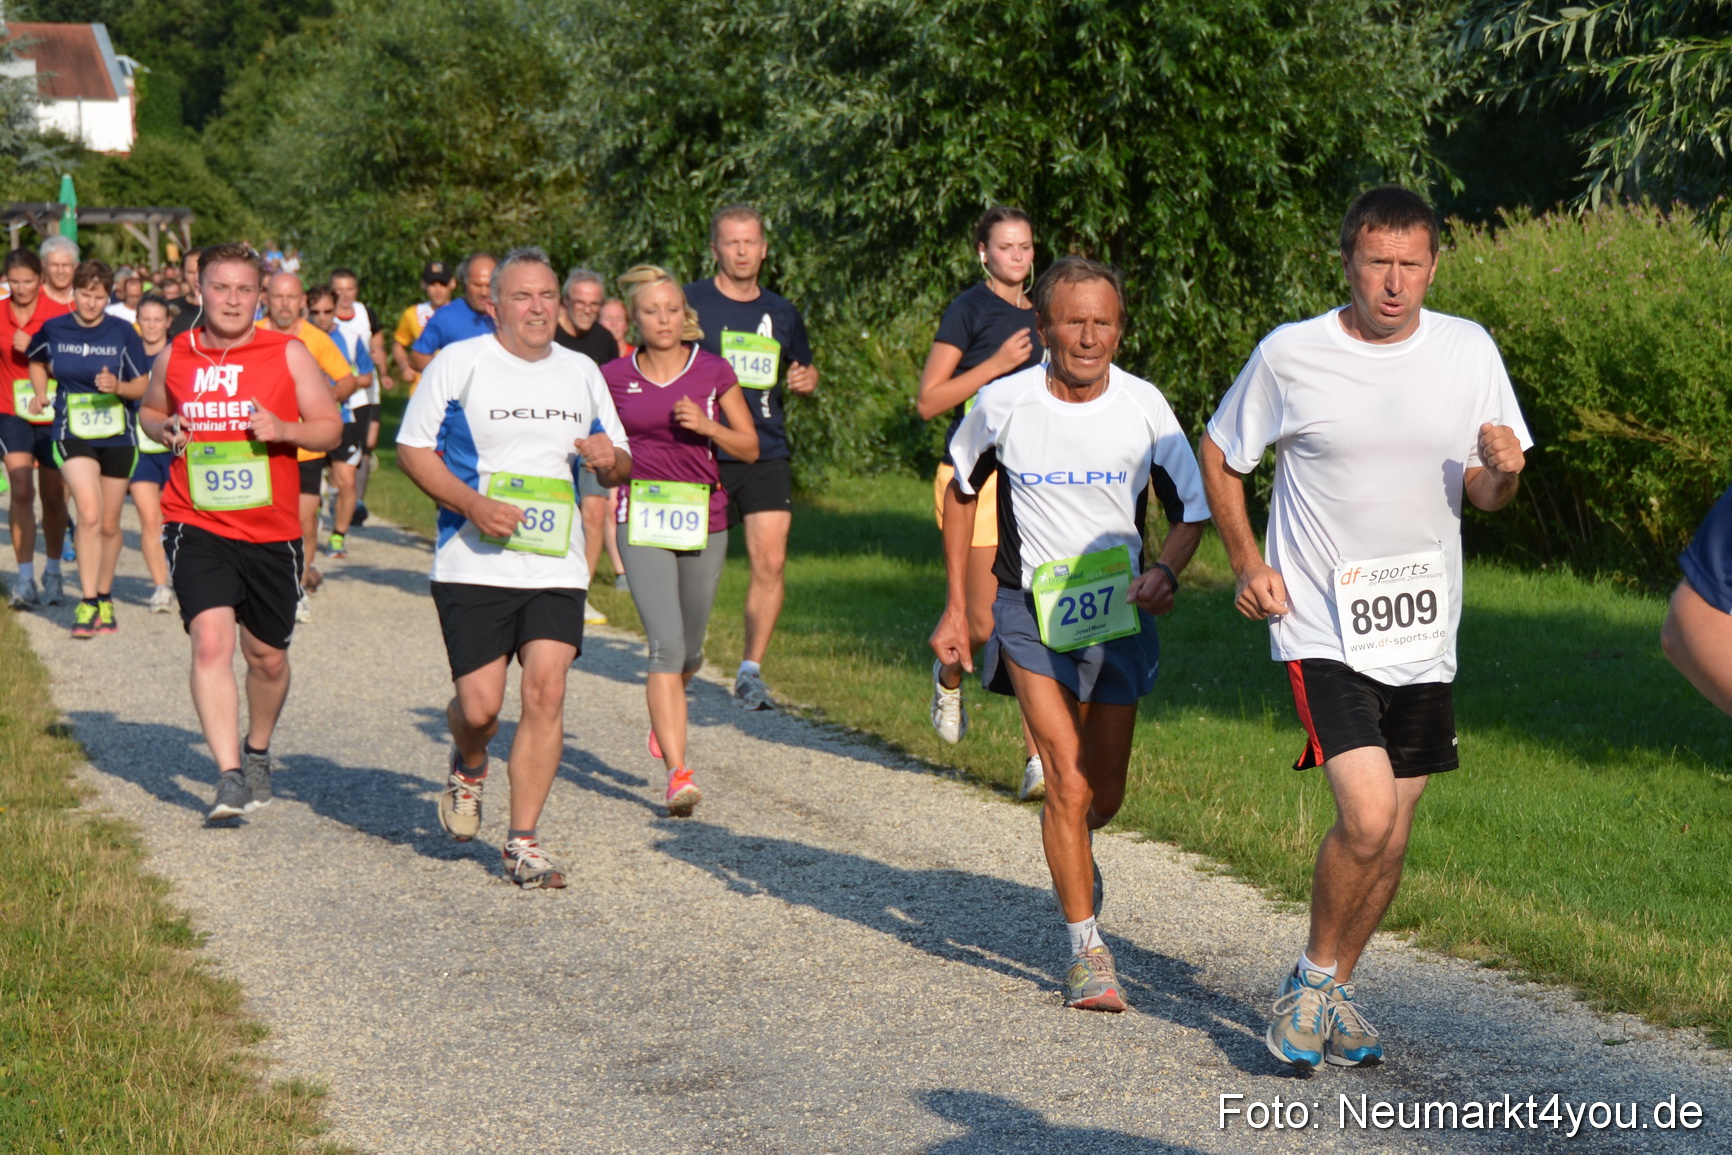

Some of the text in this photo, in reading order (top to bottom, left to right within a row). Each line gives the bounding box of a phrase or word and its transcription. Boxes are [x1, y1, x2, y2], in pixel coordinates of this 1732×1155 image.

[58, 343, 118, 356] EURO POLES
[729, 354, 772, 374] 1148
[193, 363, 244, 397] MRT
[80, 410, 113, 426] 375
[489, 408, 582, 423] DELPHI
[205, 469, 253, 492] 959
[1019, 471, 1127, 486] DELPHI
[522, 508, 556, 533] 68
[640, 508, 699, 532] 1109
[1340, 563, 1430, 586] df-sports
[1380, 576, 1406, 586] moderne
[1406, 571, 1443, 582] Zeitmessung
[1058, 586, 1115, 626] 287
[1350, 589, 1438, 635] 8909
[1349, 629, 1446, 652] www.df-sports.de
